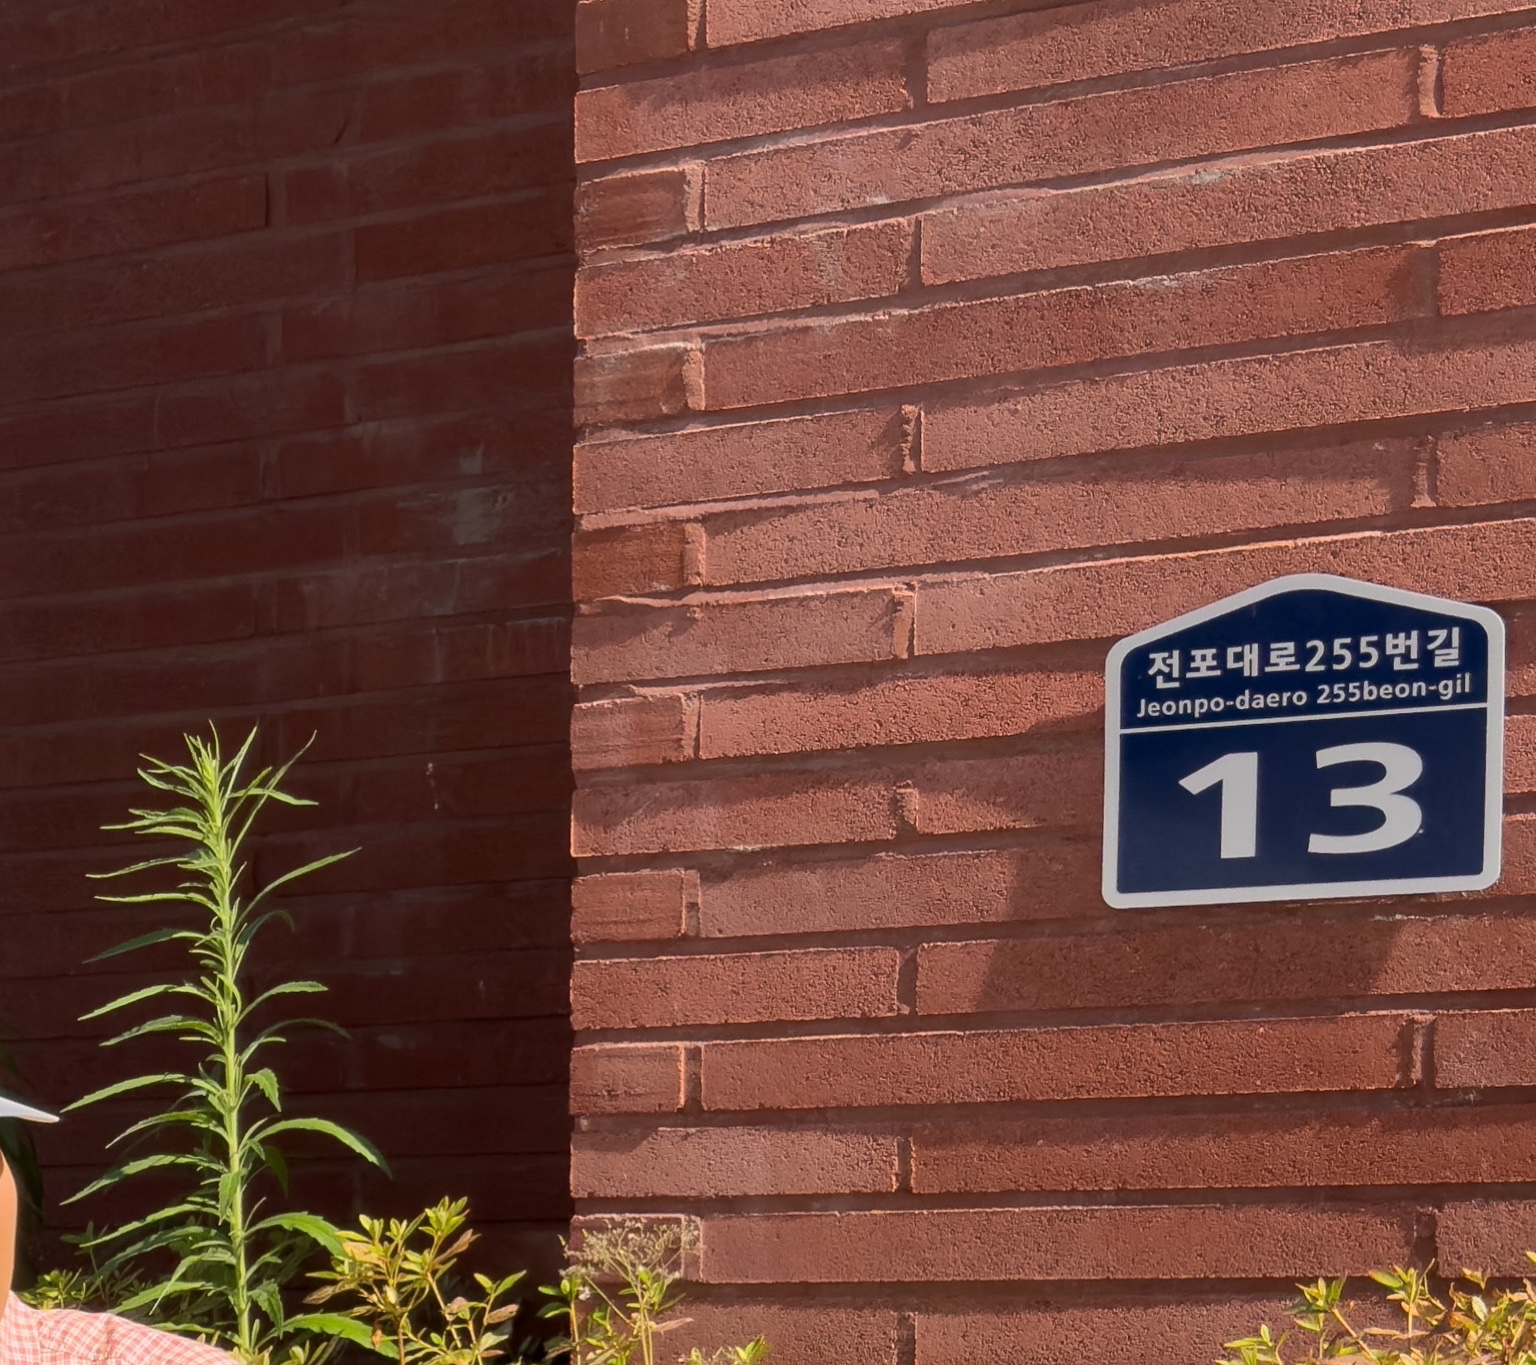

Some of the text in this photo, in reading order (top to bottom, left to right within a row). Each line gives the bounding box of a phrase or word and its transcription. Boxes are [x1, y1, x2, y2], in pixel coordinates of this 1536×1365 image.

[1147, 626, 1461, 689] 전포대로255번길
[1136, 672, 1471, 718] Jeonpo-daero 255beon-gil
[1178, 741, 1424, 859] 13
